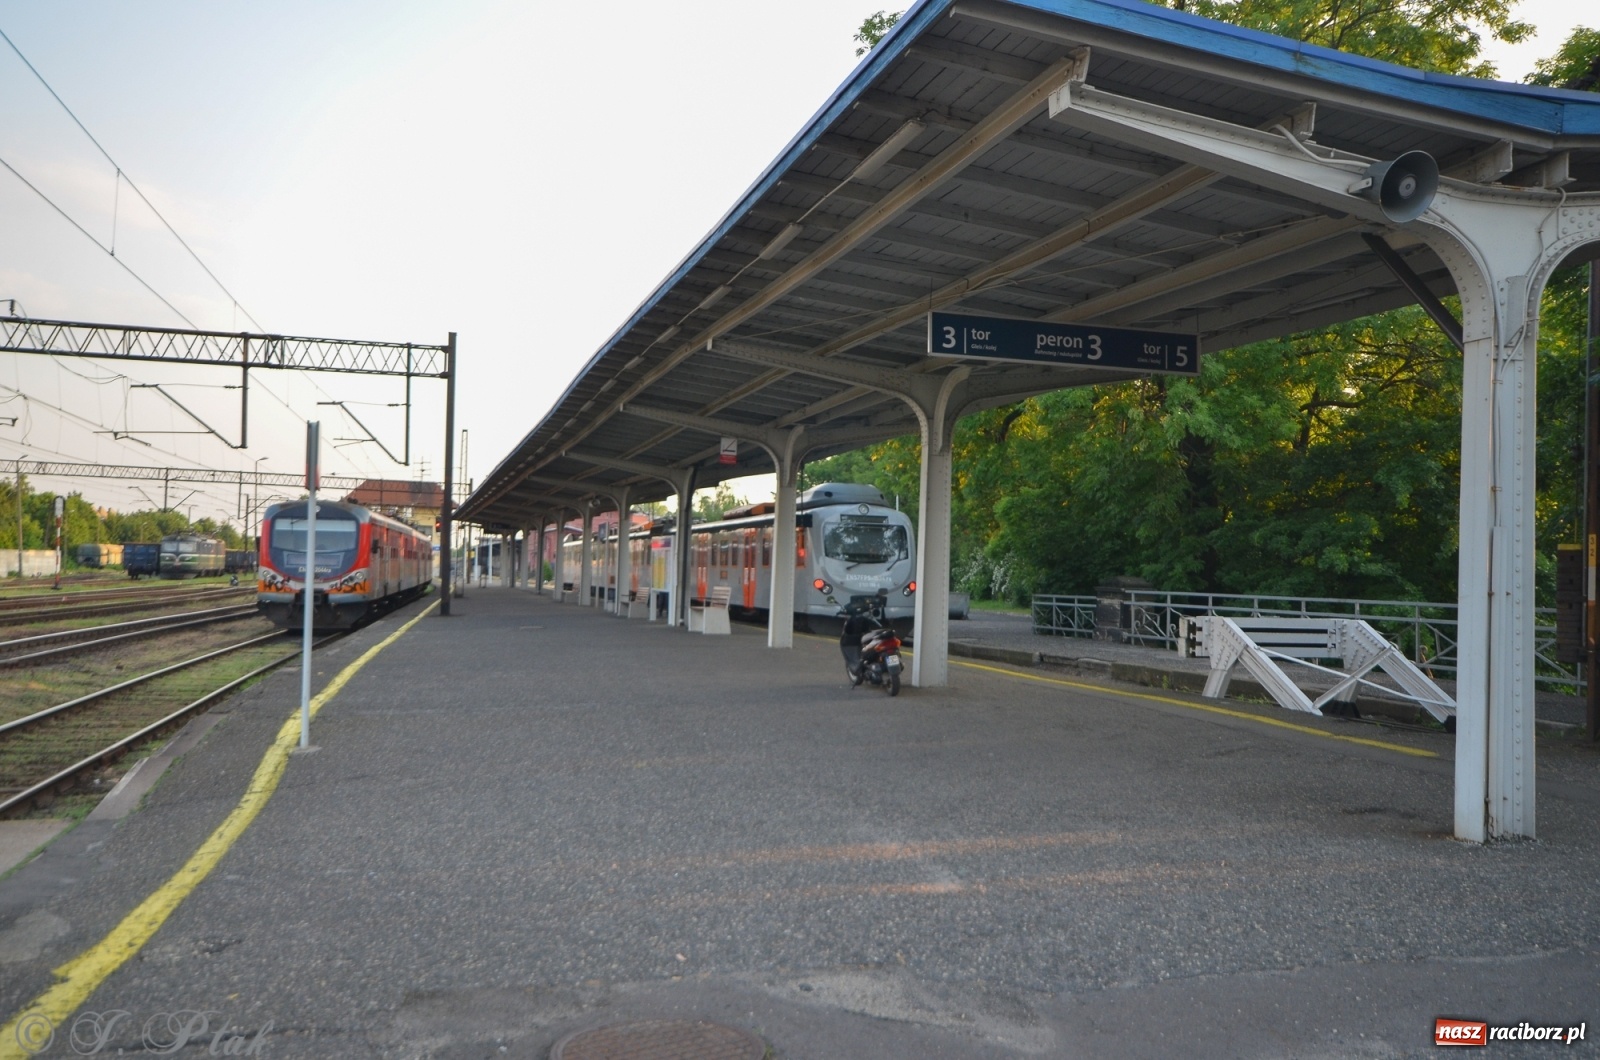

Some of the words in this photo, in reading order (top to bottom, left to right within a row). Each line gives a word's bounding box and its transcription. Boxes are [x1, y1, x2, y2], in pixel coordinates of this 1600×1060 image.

[942, 326, 957, 349] 3
[971, 328, 991, 341] tor
[1036, 333, 1083, 349] peron
[1087, 334, 1103, 360] 3
[1143, 342, 1162, 355] tor
[1175, 345, 1189, 367] 5
